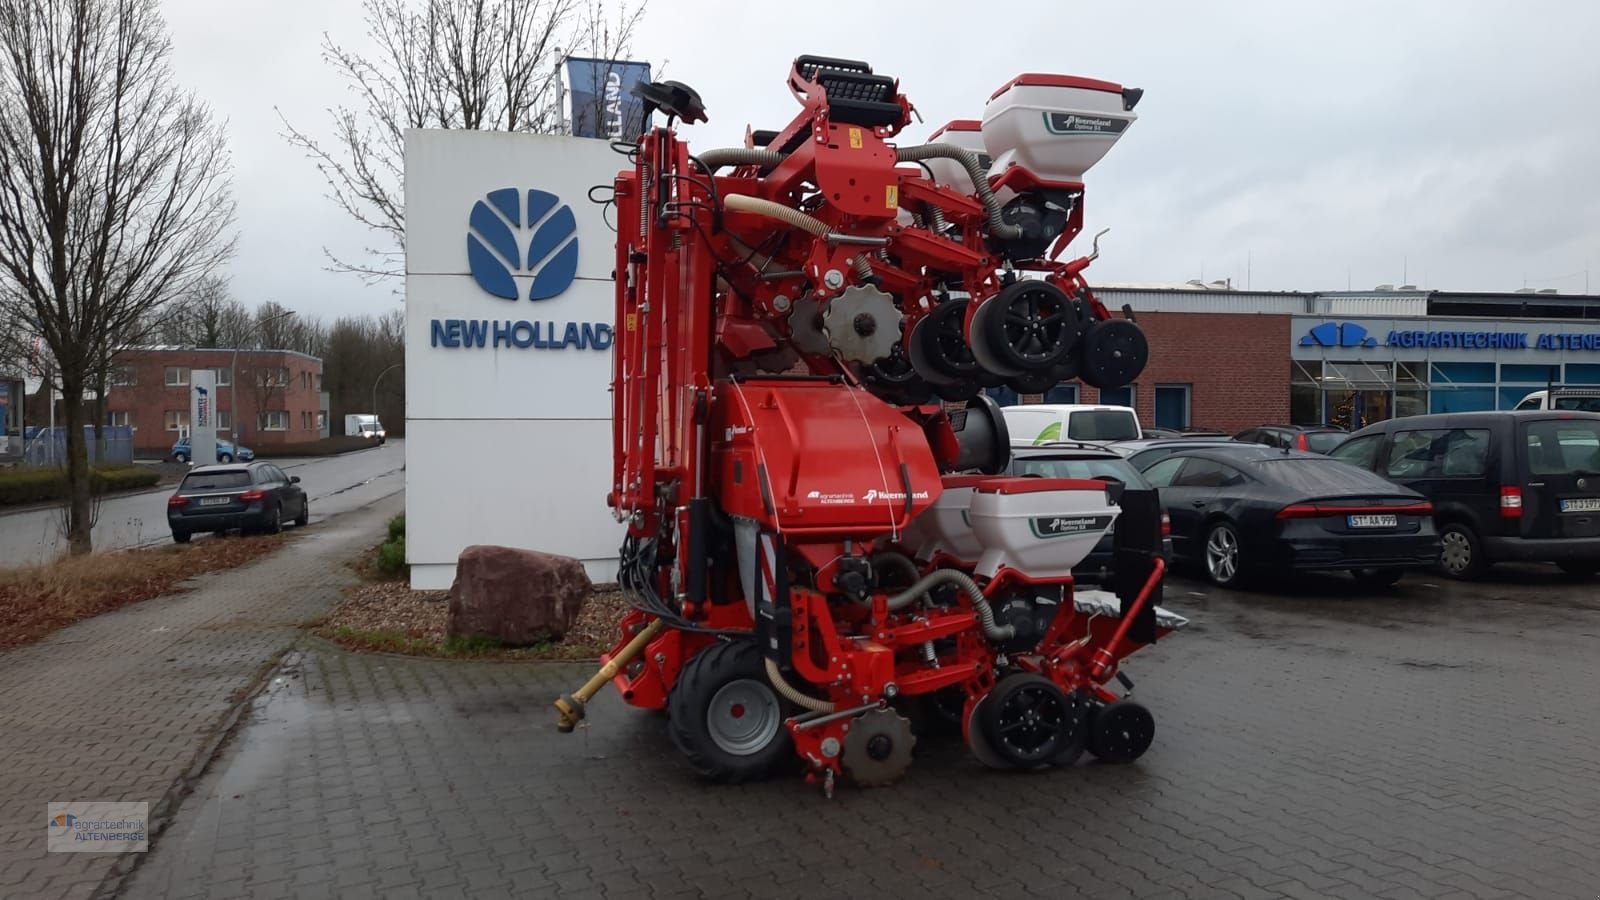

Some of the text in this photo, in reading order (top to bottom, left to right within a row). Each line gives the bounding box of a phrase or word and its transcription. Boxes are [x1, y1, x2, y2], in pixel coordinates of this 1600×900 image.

[605, 71, 622, 142] LLAND
[430, 319, 613, 350] NEW HOLLAND
[1387, 330, 1528, 349] AGRARTECHNIK
